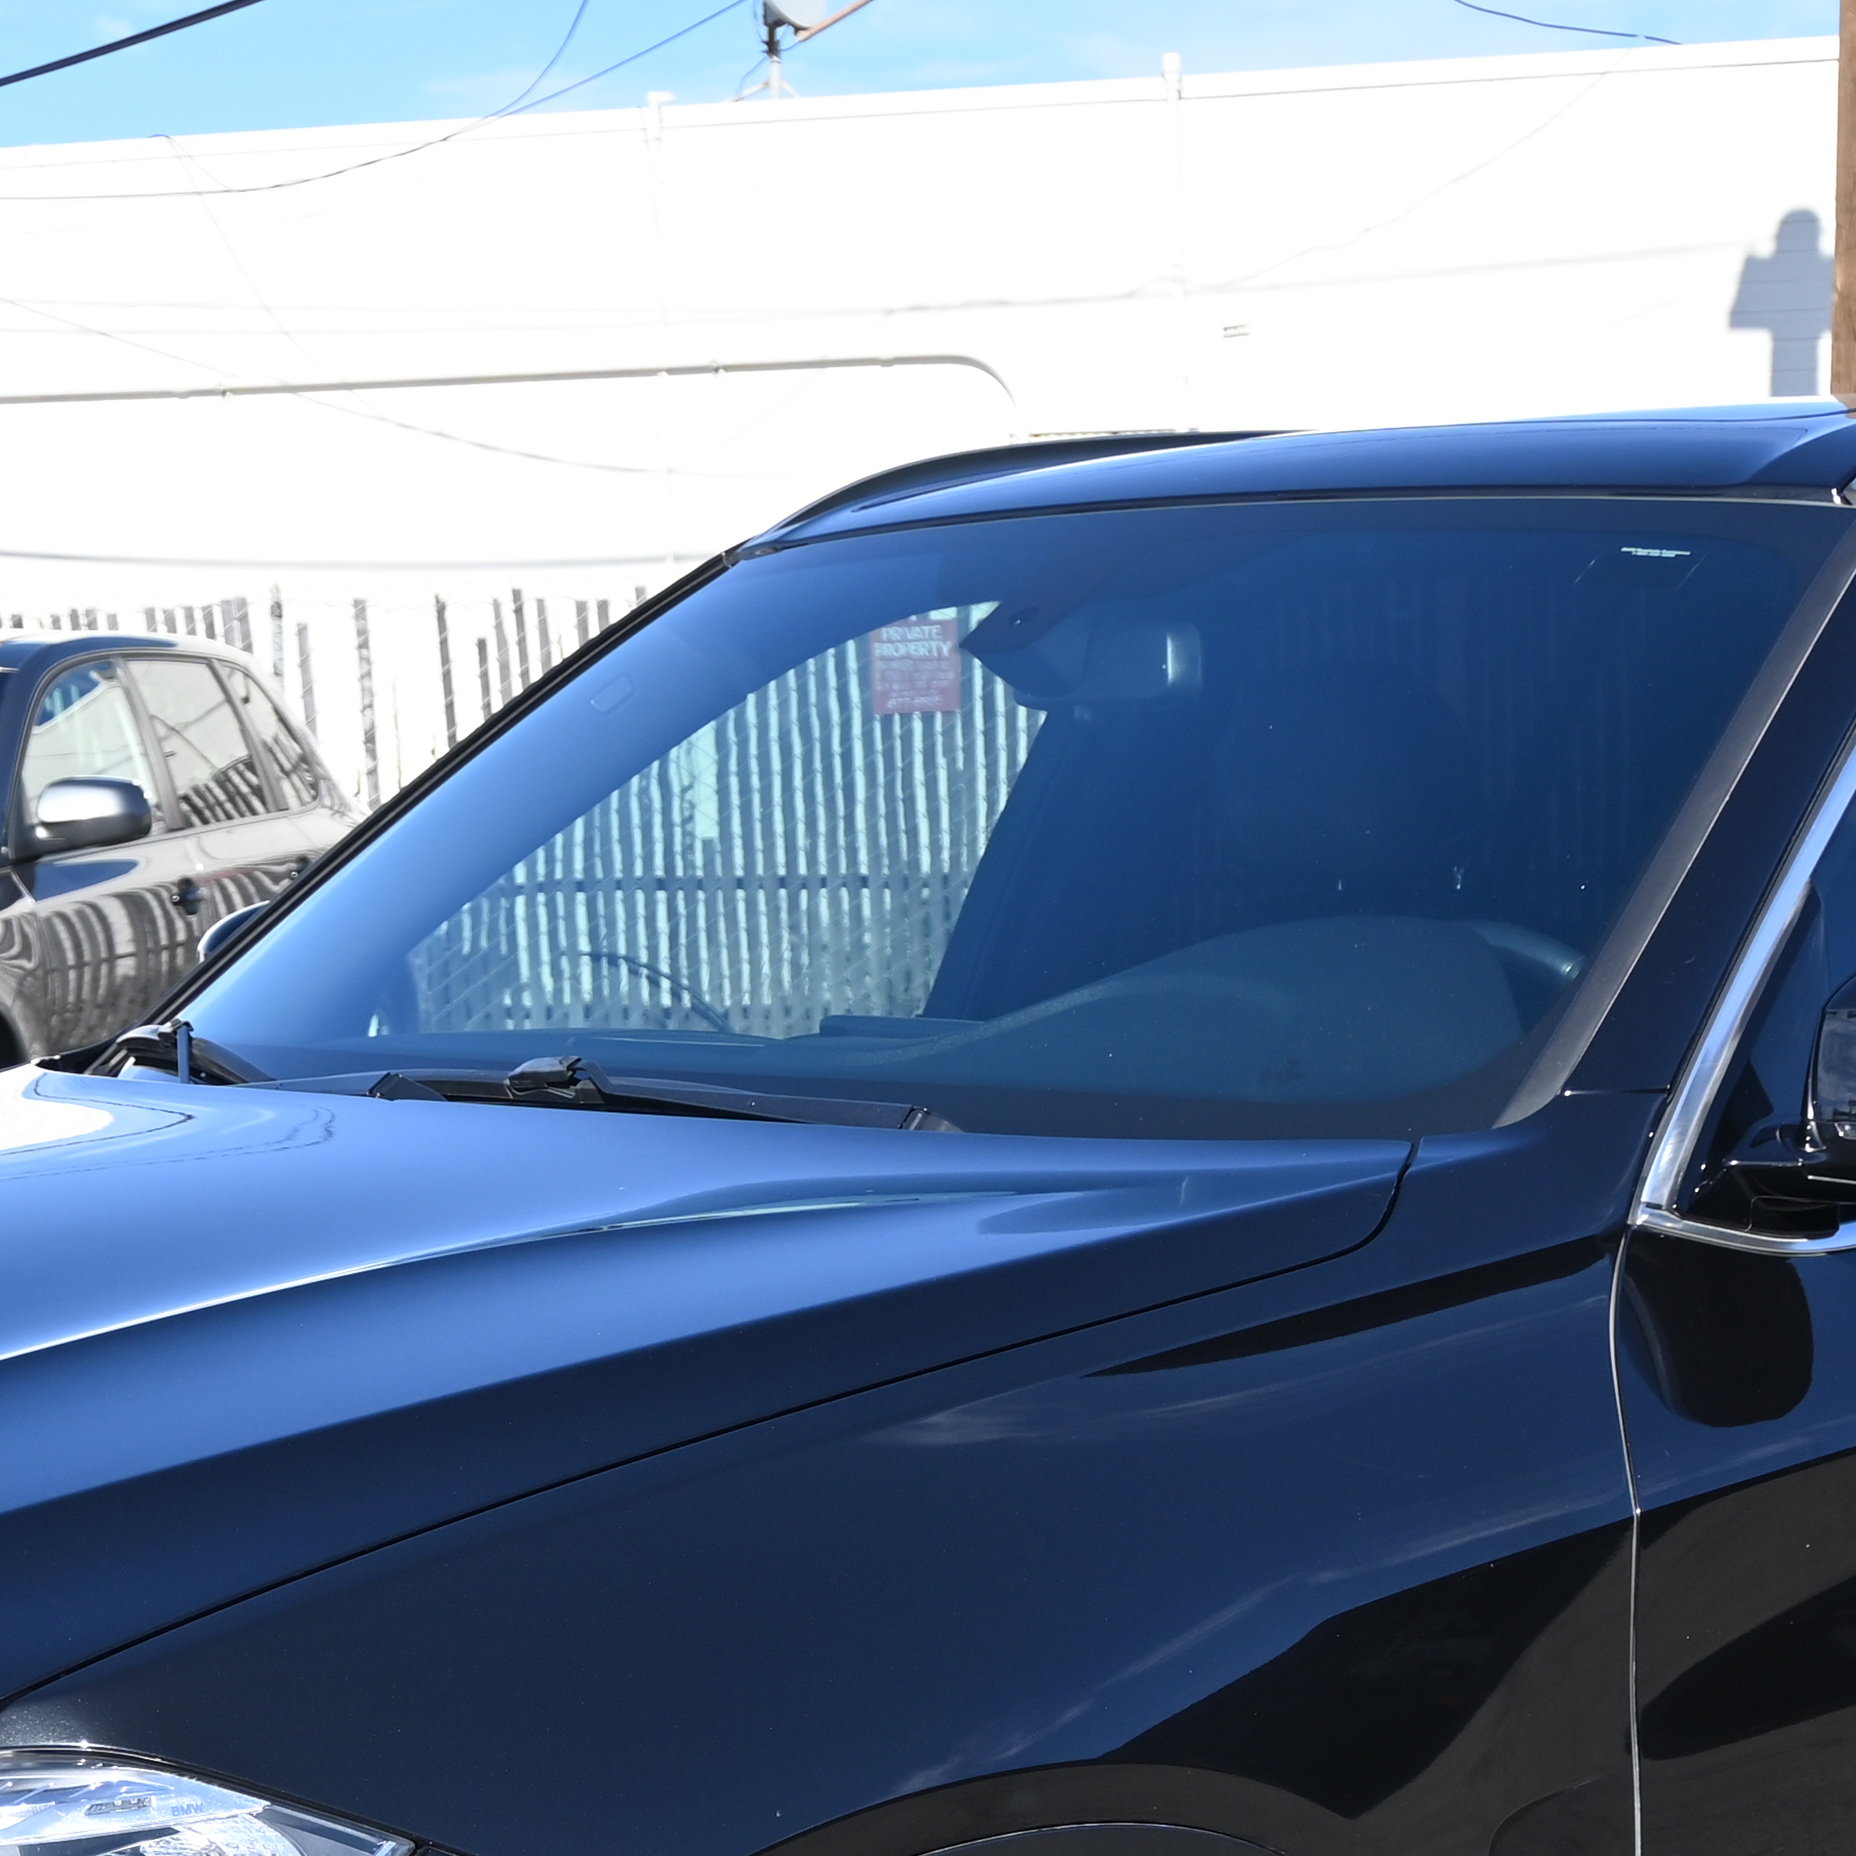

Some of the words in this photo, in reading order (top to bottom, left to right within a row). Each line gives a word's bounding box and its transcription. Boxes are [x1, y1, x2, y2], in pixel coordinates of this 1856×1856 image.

[882, 625, 942, 641] PRIVATE
[874, 641, 952, 657] PROPERTY
[171, 1803, 204, 1817] BMW
